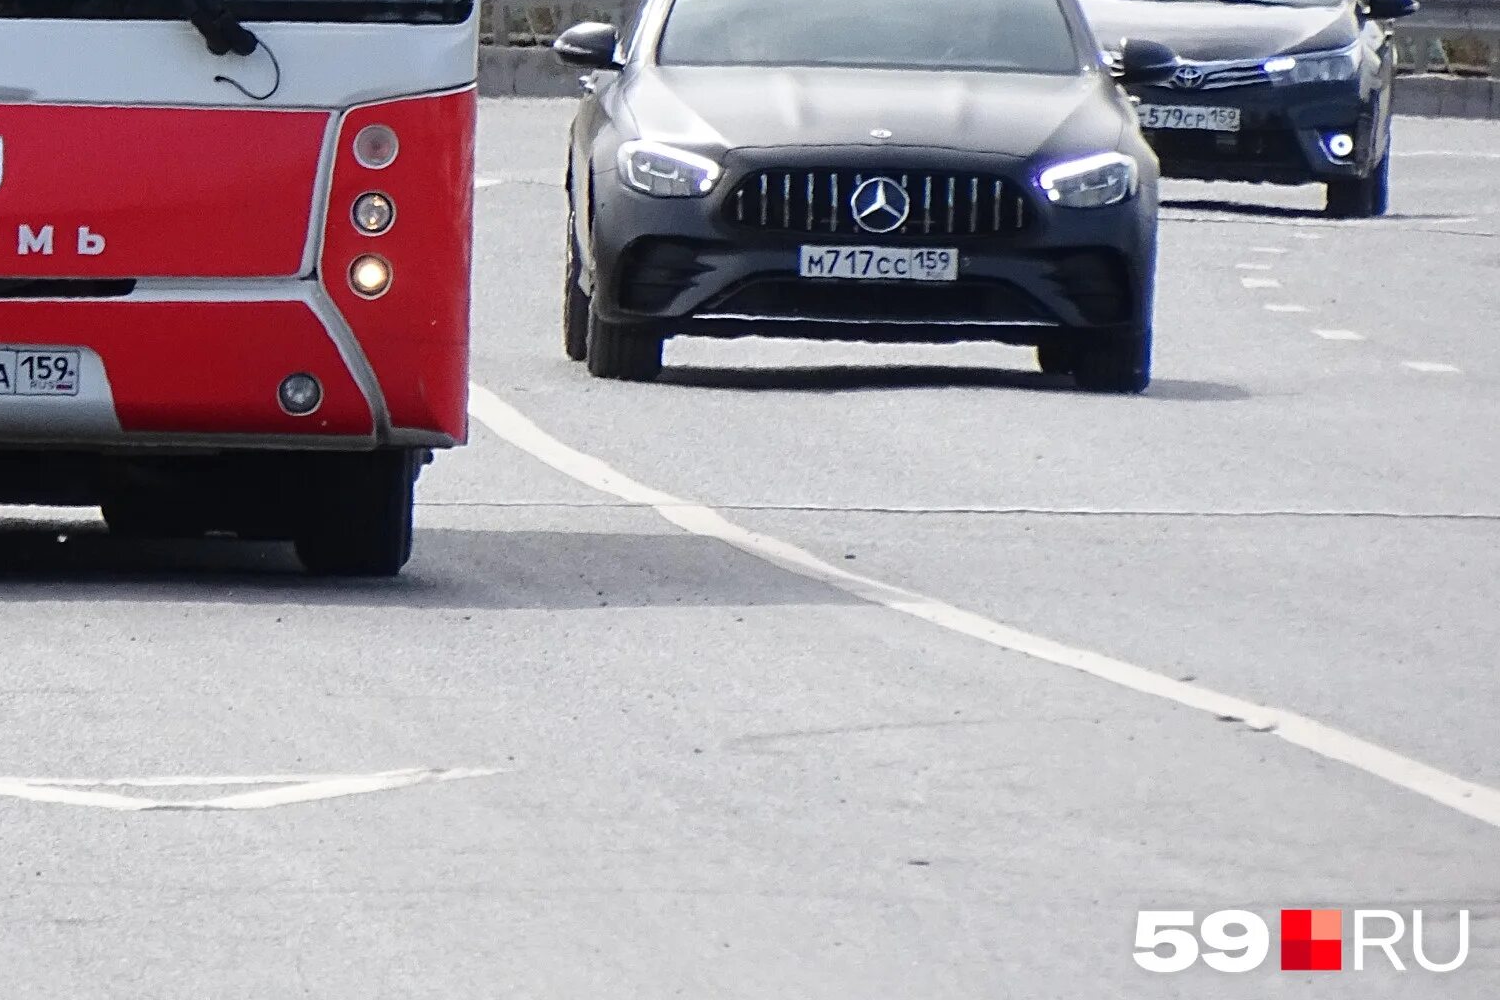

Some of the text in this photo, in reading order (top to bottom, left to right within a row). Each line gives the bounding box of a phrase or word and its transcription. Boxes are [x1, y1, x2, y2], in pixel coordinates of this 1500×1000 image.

[1210, 109, 1237, 125] 159
[807, 250, 951, 276] М717СС 159
[20, 355, 70, 381] 159
